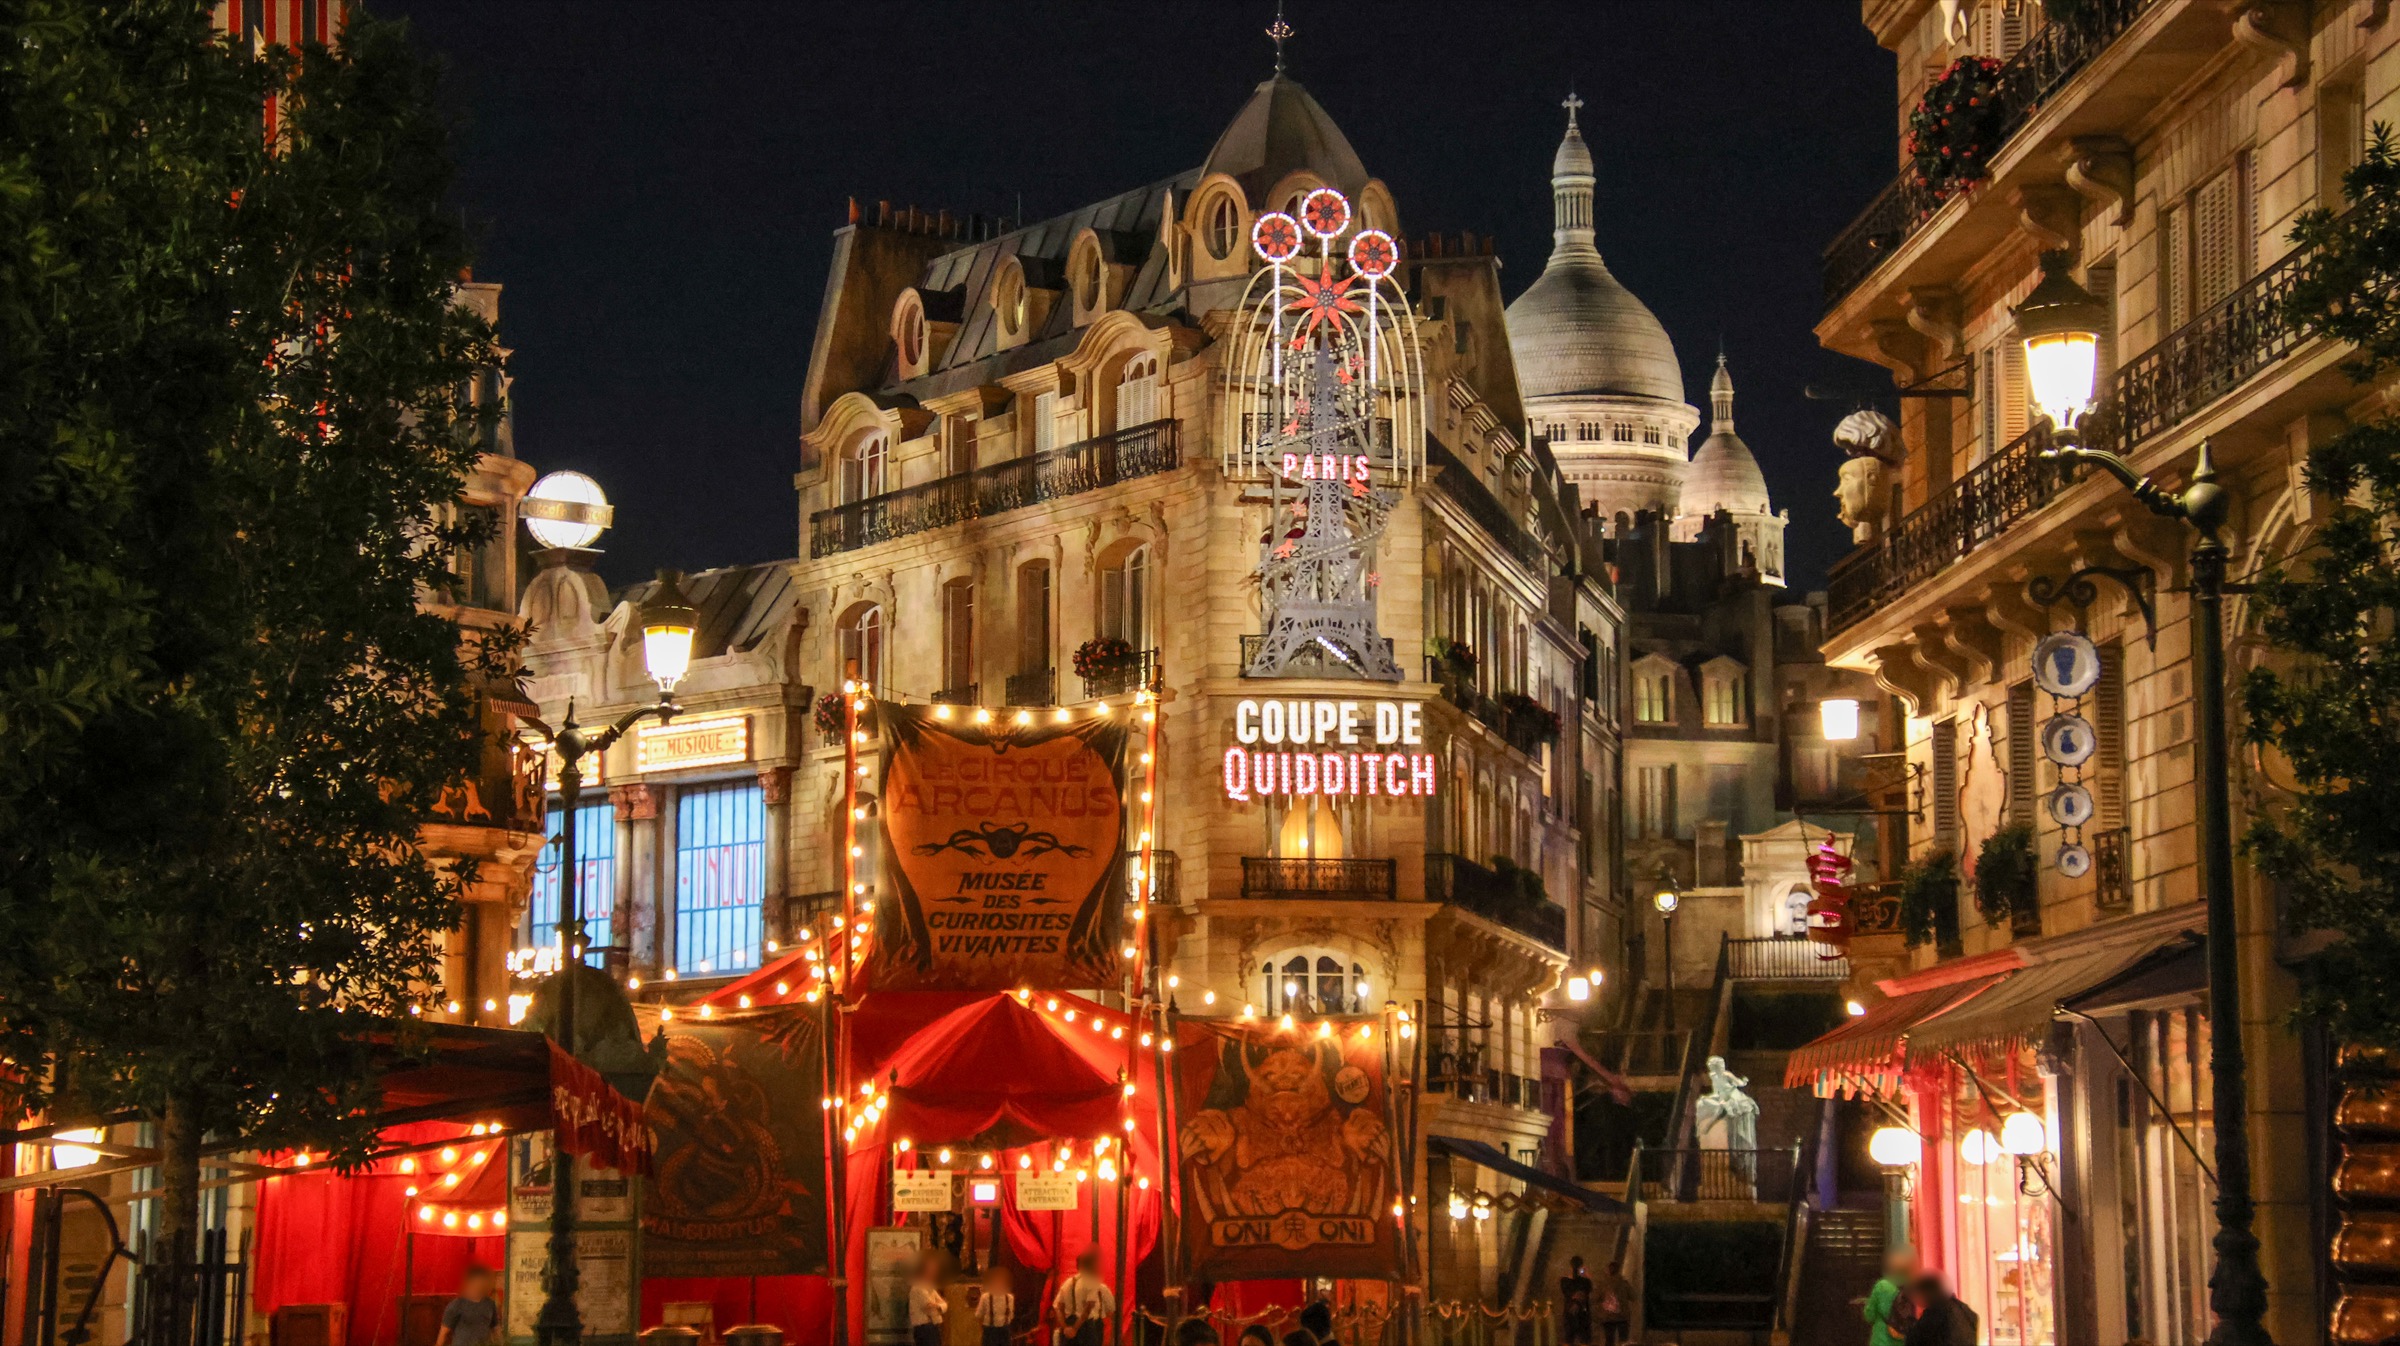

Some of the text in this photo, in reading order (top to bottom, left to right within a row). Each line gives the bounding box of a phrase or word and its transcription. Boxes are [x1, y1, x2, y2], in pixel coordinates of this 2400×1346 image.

[1282, 453, 1370, 481] PARIS
[1236, 699, 1422, 744] COUPE DE
[667, 733, 723, 756] MUSIQUE
[958, 757, 1089, 783] CIRQUE
[1223, 746, 1436, 801] QUIDDITCH
[892, 784, 1115, 818] ARCANUS
[957, 870, 1048, 894] MUSÉE
[982, 895, 1022, 909] DES
[938, 935, 1060, 958] VIVANTES
[901, 1197, 940, 1205] ENTRANCE
[912, 1189, 944, 1197] EXPRESS
[1024, 1188, 1069, 1196] ATTRACTION
[1223, 1221, 1270, 1243] ONI
[1318, 1220, 1366, 1241] ONI
